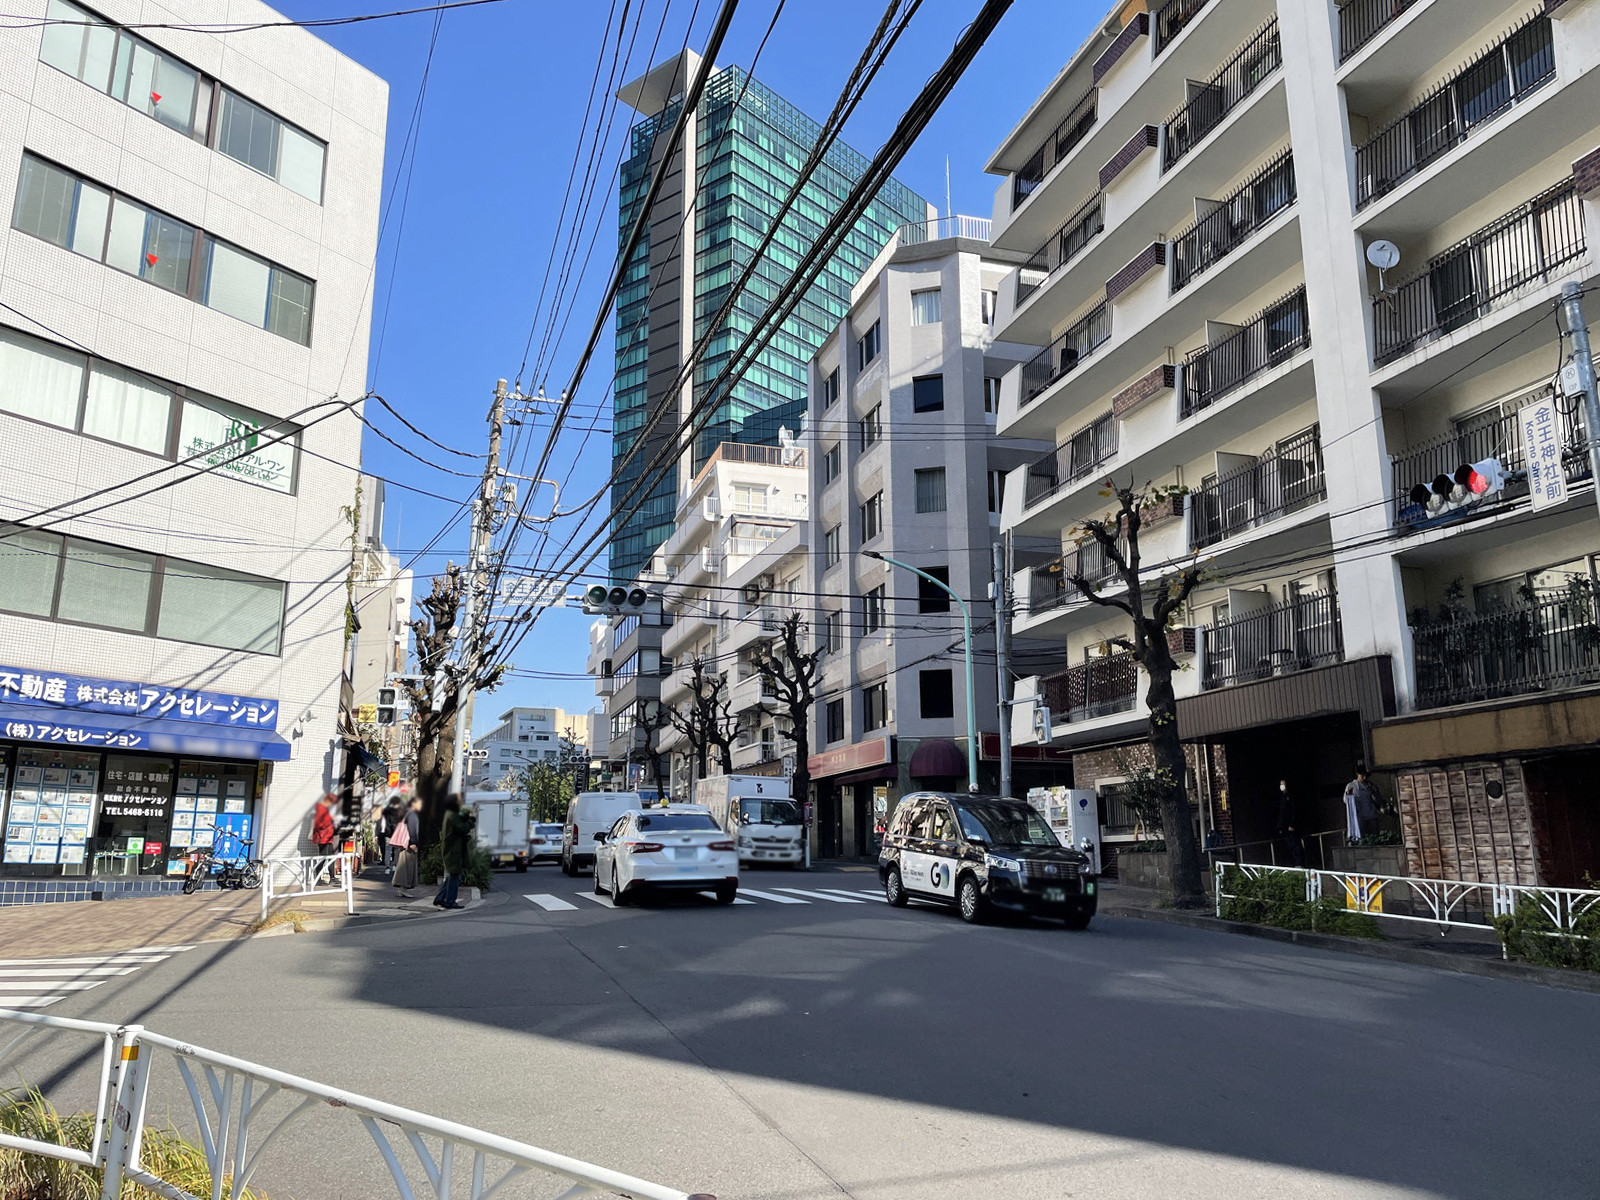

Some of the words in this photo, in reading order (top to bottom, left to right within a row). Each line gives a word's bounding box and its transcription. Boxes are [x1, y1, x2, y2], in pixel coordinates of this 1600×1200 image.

[1525, 421, 1537, 459] Kon-no
[1531, 461, 1542, 495] Shrine
[1534, 406, 1561, 500] 金王神社前
[0, 672, 67, 703] 不動産
[105, 807, 122, 815] TEL
